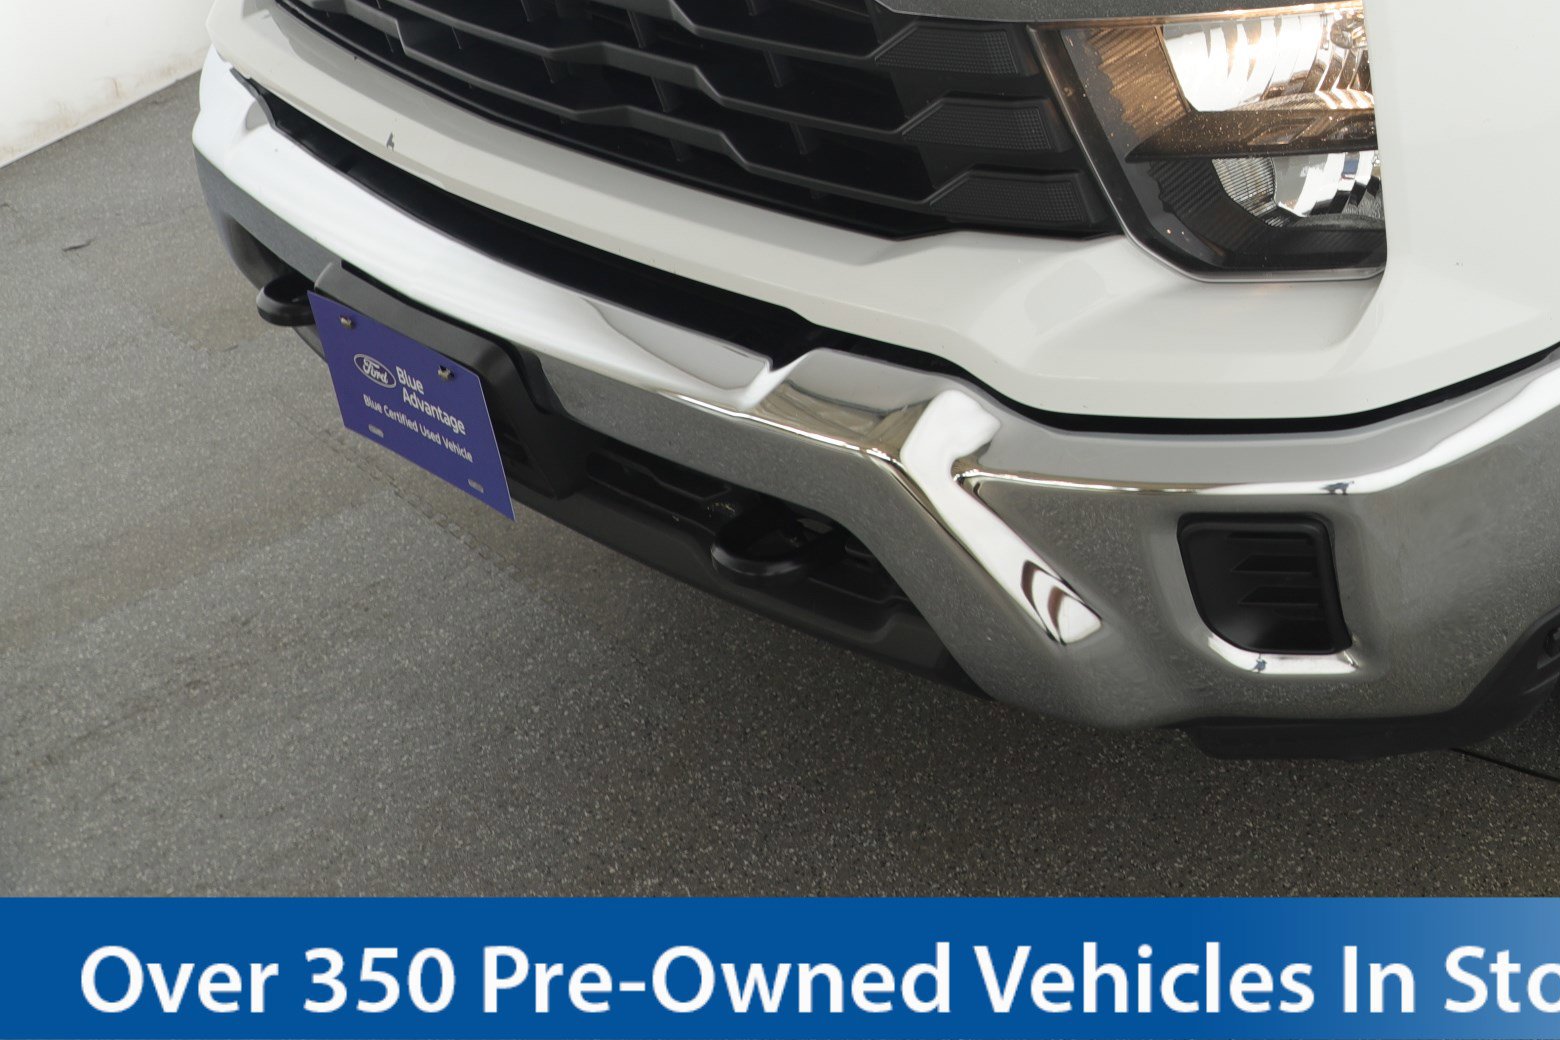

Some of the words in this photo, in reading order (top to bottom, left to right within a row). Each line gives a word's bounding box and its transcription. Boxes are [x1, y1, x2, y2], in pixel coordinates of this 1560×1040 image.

[363, 358, 390, 385] Ford
[395, 366, 425, 395] Blue
[363, 394, 383, 414] Blue
[383, 404, 419, 433] Certified
[419, 423, 442, 446] Used
[442, 435, 474, 463] Vehicle
[402, 388, 466, 435] Advantage
